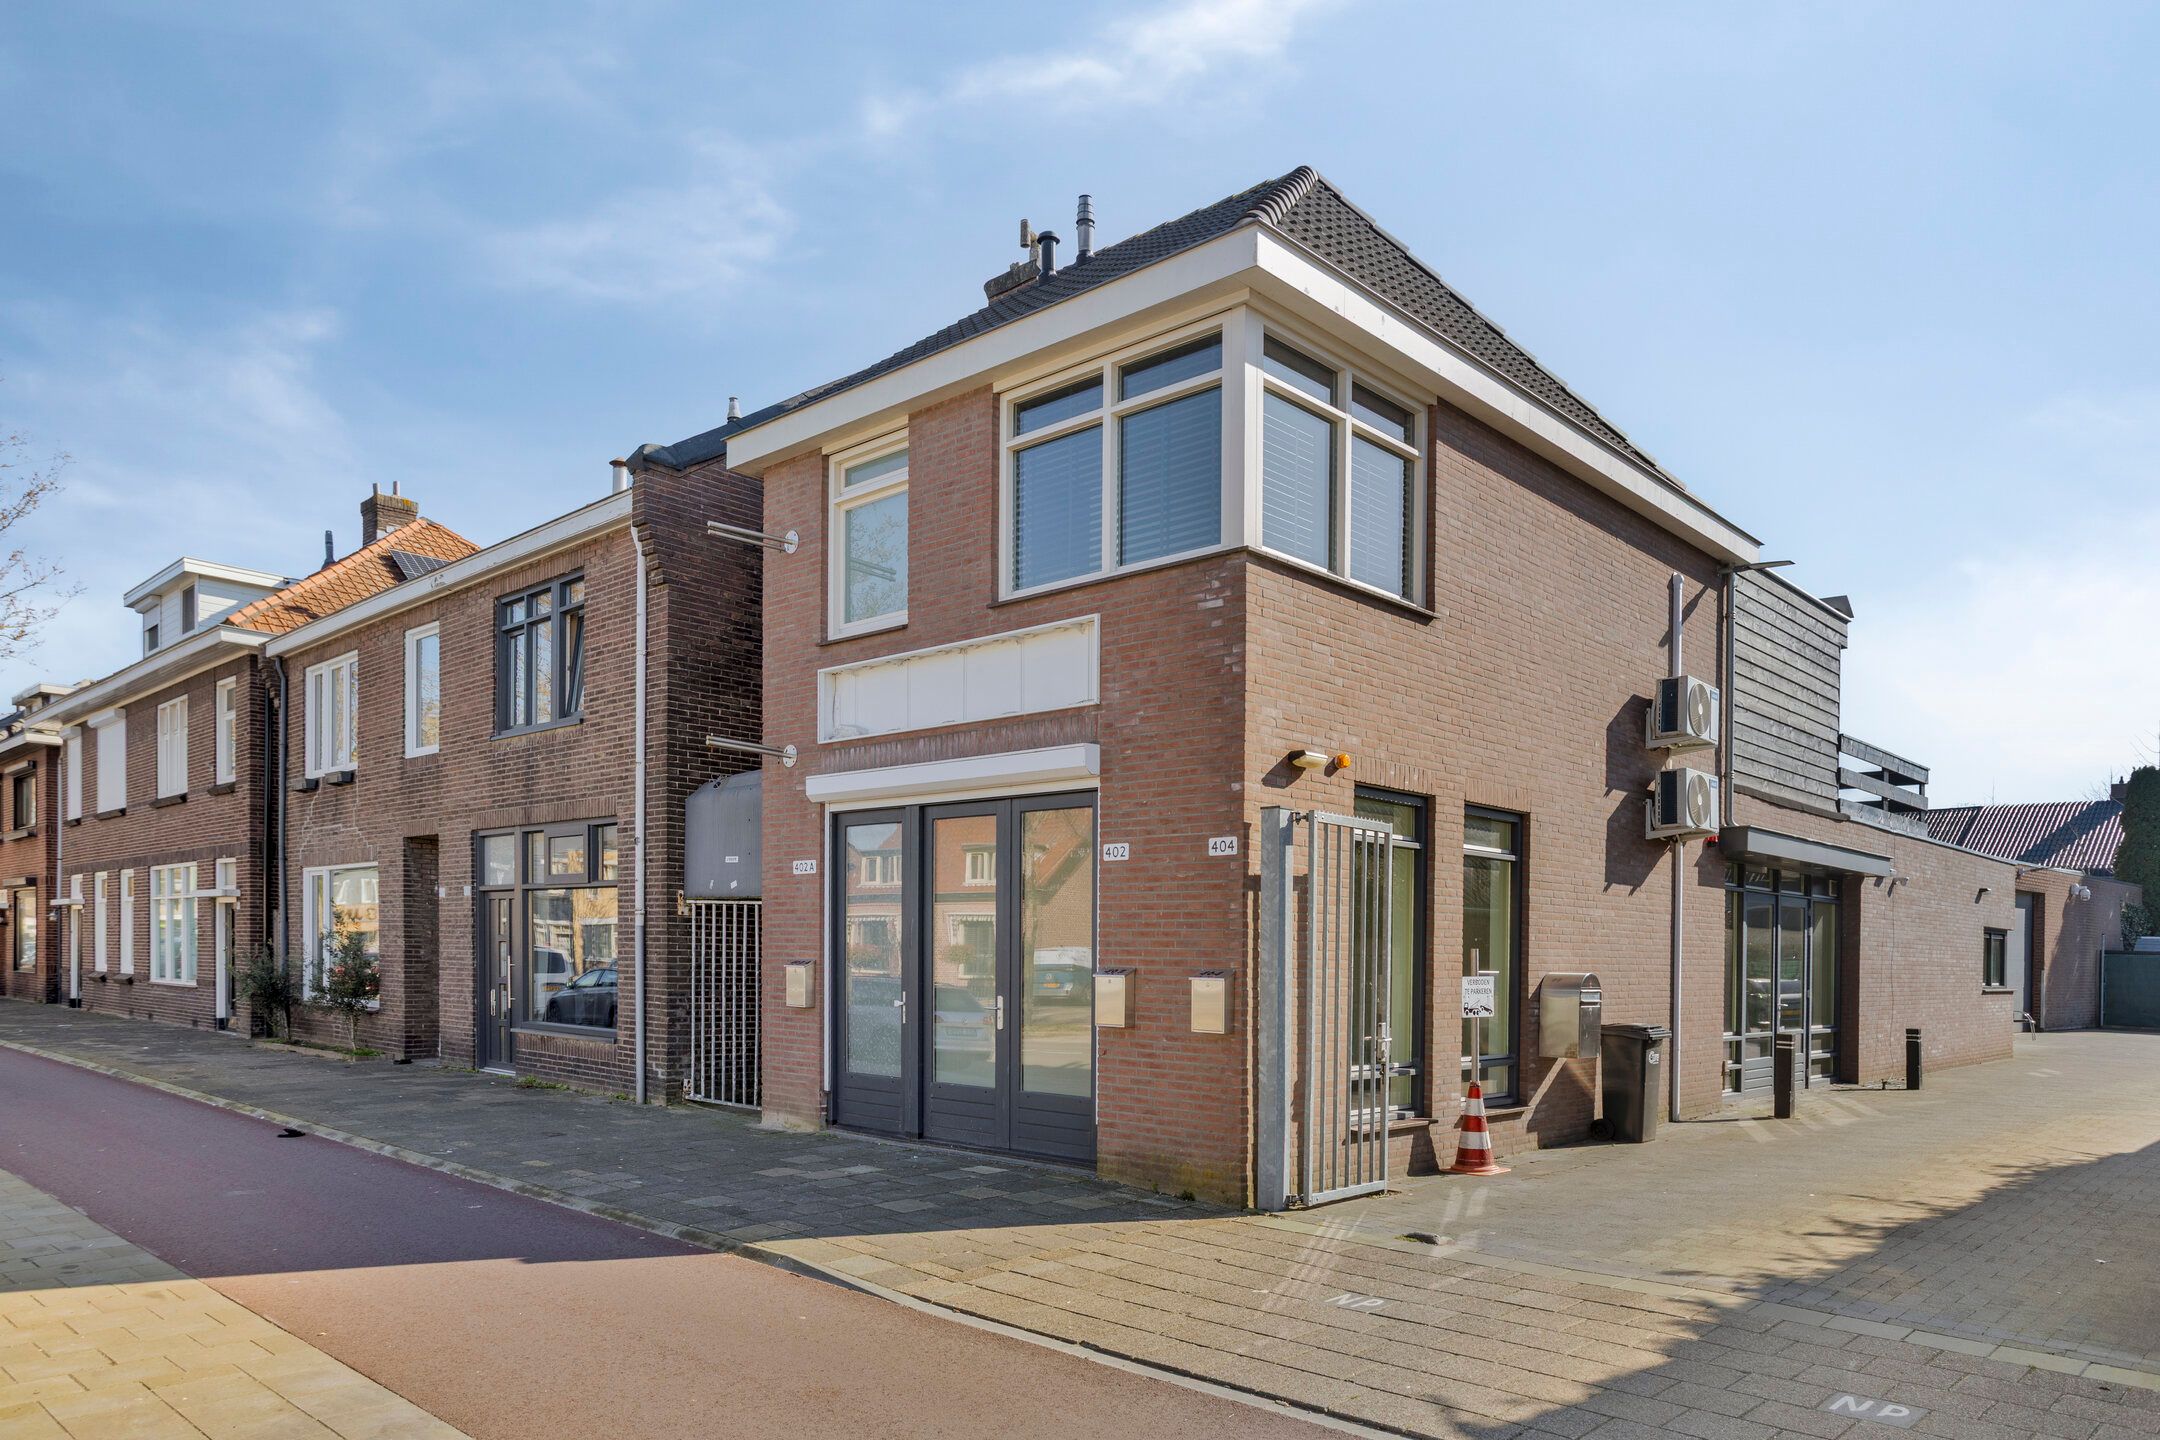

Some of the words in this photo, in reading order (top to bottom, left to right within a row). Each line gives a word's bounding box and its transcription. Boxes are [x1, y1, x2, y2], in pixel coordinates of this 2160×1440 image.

[1105, 845, 1126, 858] 402
[1211, 840, 1235, 853] 404
[794, 862, 815, 872] 402A
[1324, 1293, 1385, 1308] NP
[1828, 1395, 1910, 1417] NP
